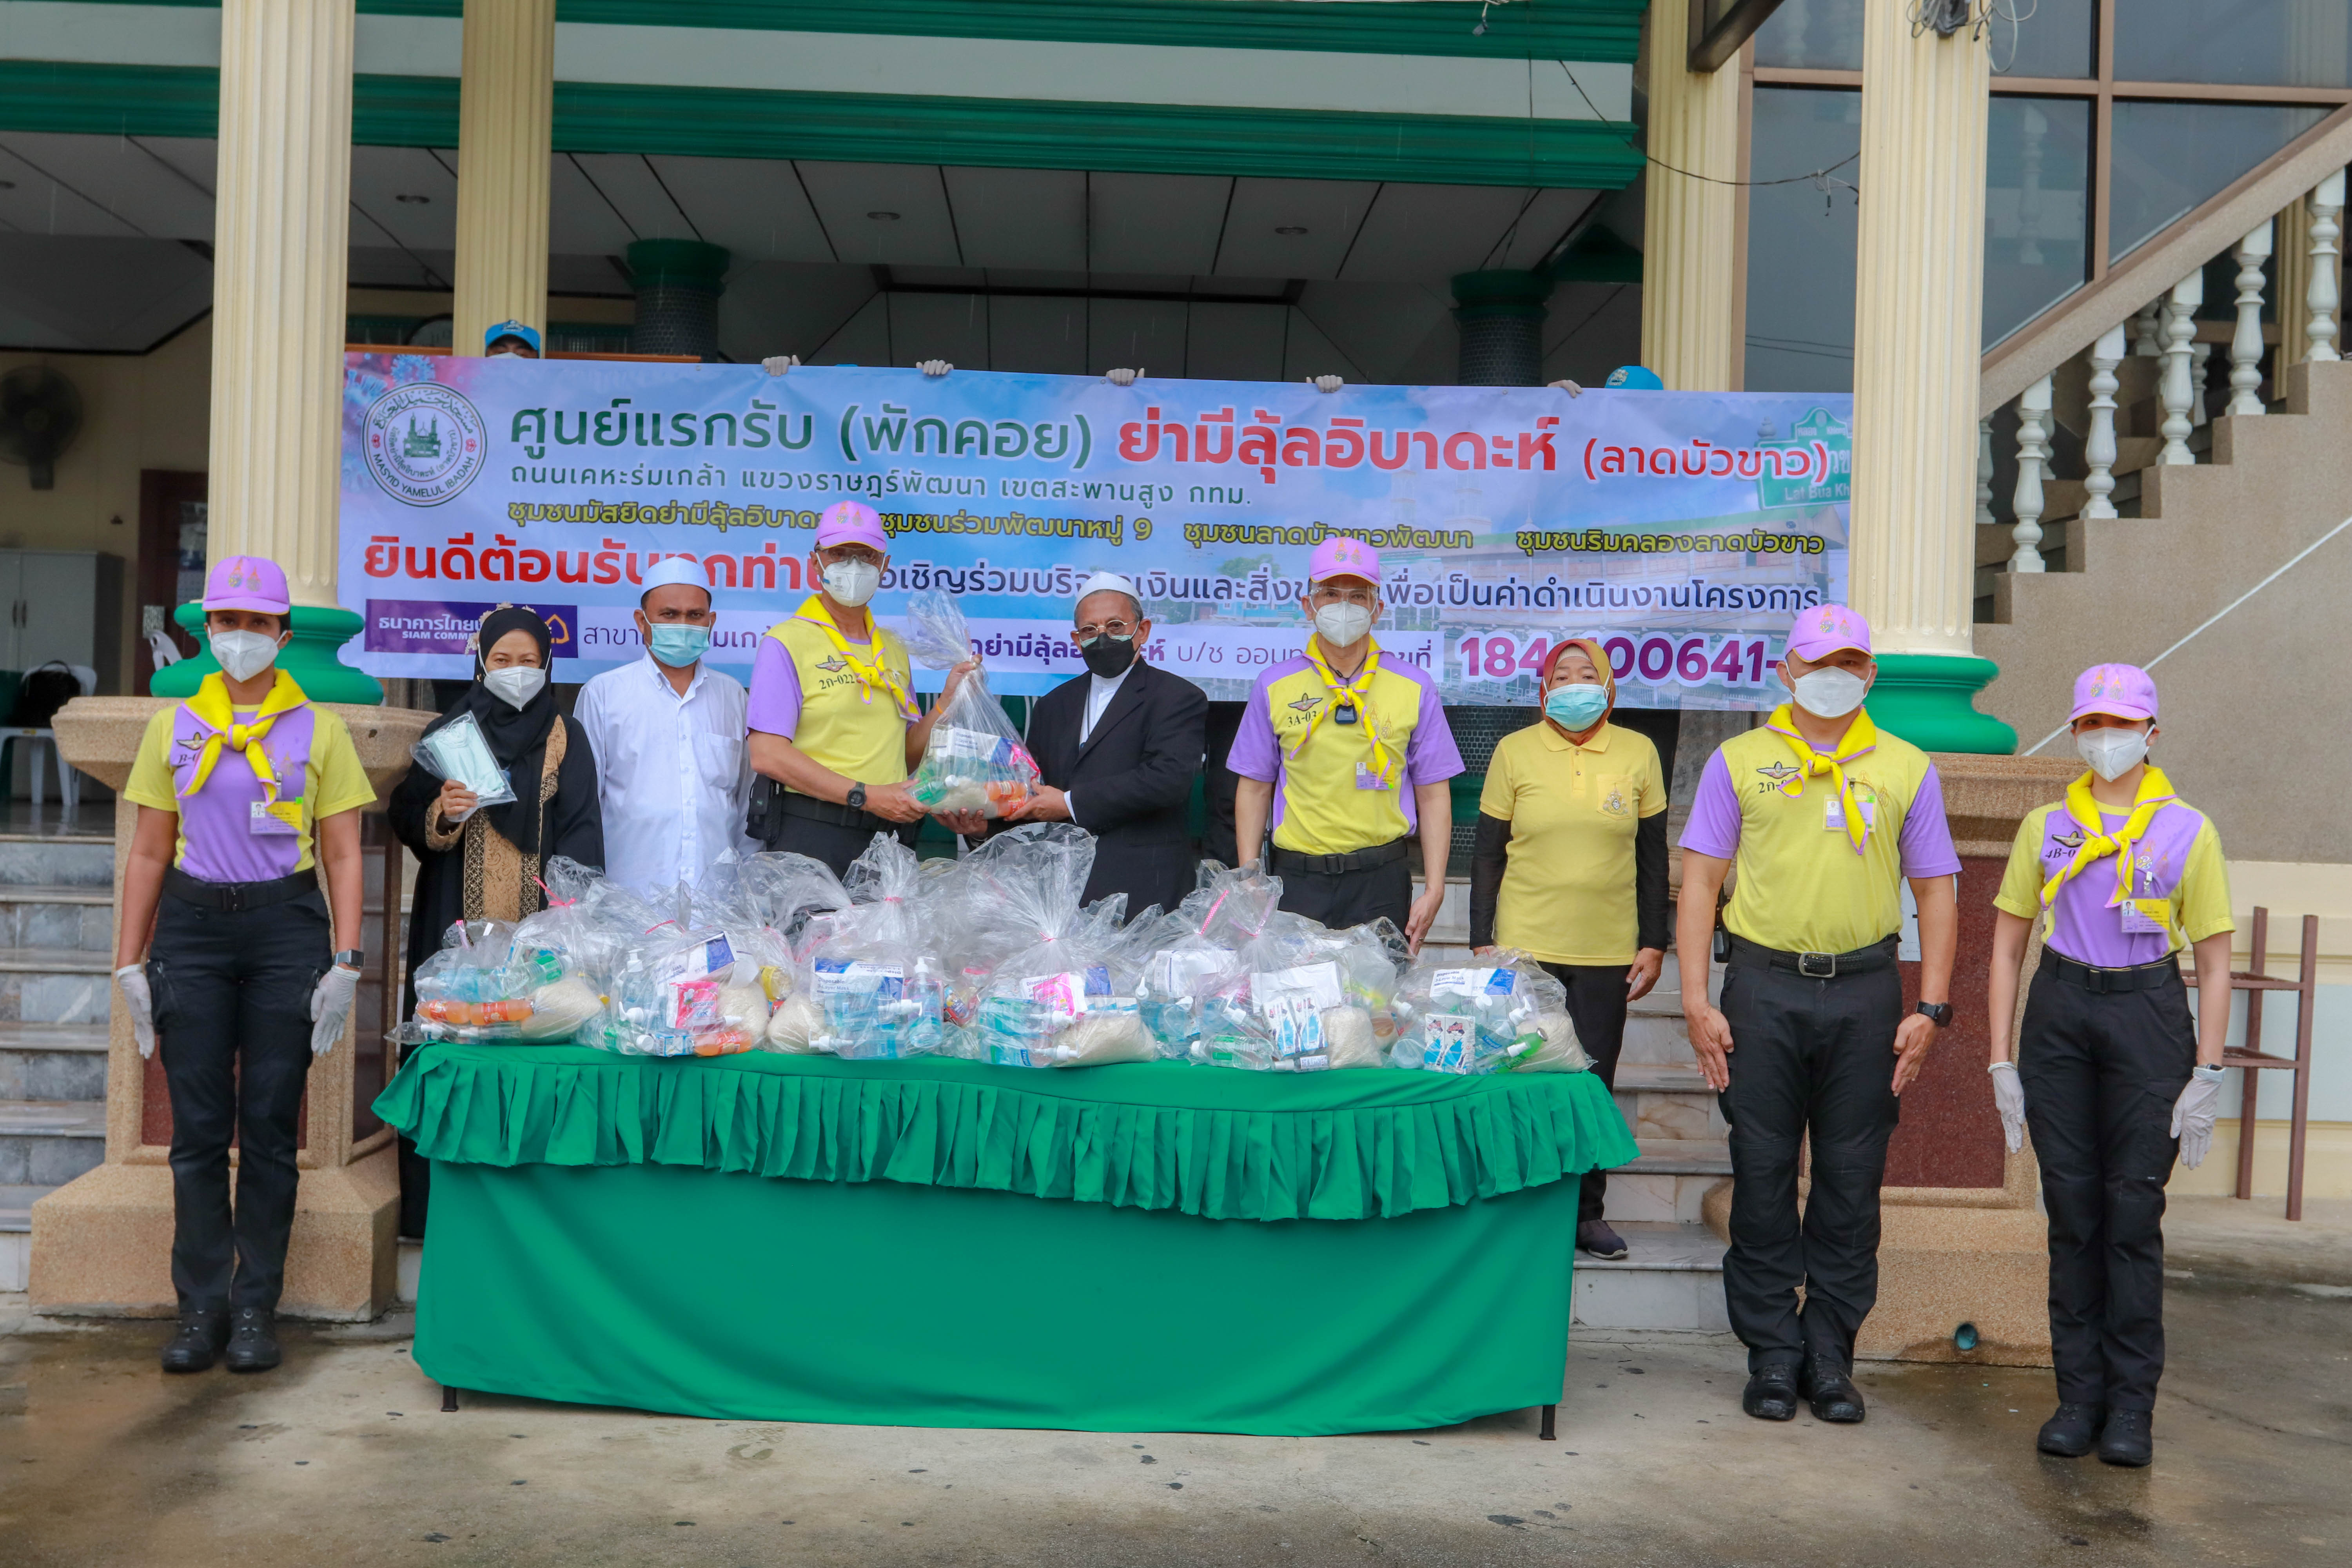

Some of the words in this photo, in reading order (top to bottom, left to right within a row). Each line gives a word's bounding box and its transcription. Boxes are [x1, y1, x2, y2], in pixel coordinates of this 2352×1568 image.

[511, 398, 813, 459] ศูนย์แรกรับ
[840, 403, 1091, 469] (พักคอย)
[1118, 407, 1560, 484] ย่ามีลุ้ลอิบาดะห์
[1584, 438, 1828, 483] (ลาดบัวขาว)
[374, 454, 399, 487] MASYID
[402, 483, 445, 497] YAMELUL
[445, 457, 475, 489] IBADAH
[511, 463, 726, 487] ถนนเคหะร่มเกล้า
[741, 468, 985, 498] แขวงราษฎร์พัฒนา
[1001, 478, 1174, 508] เขตสะพานสูง
[1189, 486, 1251, 505] กทม.
[1809, 487, 1832, 499] Bua
[508, 499, 822, 533] ชุมชนมัสยิดย่ามีลุ้ลอิบาด
[1133, 518, 1152, 541] 9
[1515, 528, 1825, 557] ชุมชนริมคลองลาดบัวขาว
[379, 613, 481, 631] ธนาคารไทย
[402, 631, 431, 639] SIAM
[434, 632, 474, 641] COMM
[1177, 641, 1223, 664] บ/ช
[1287, 710, 1321, 727] 3A-03
